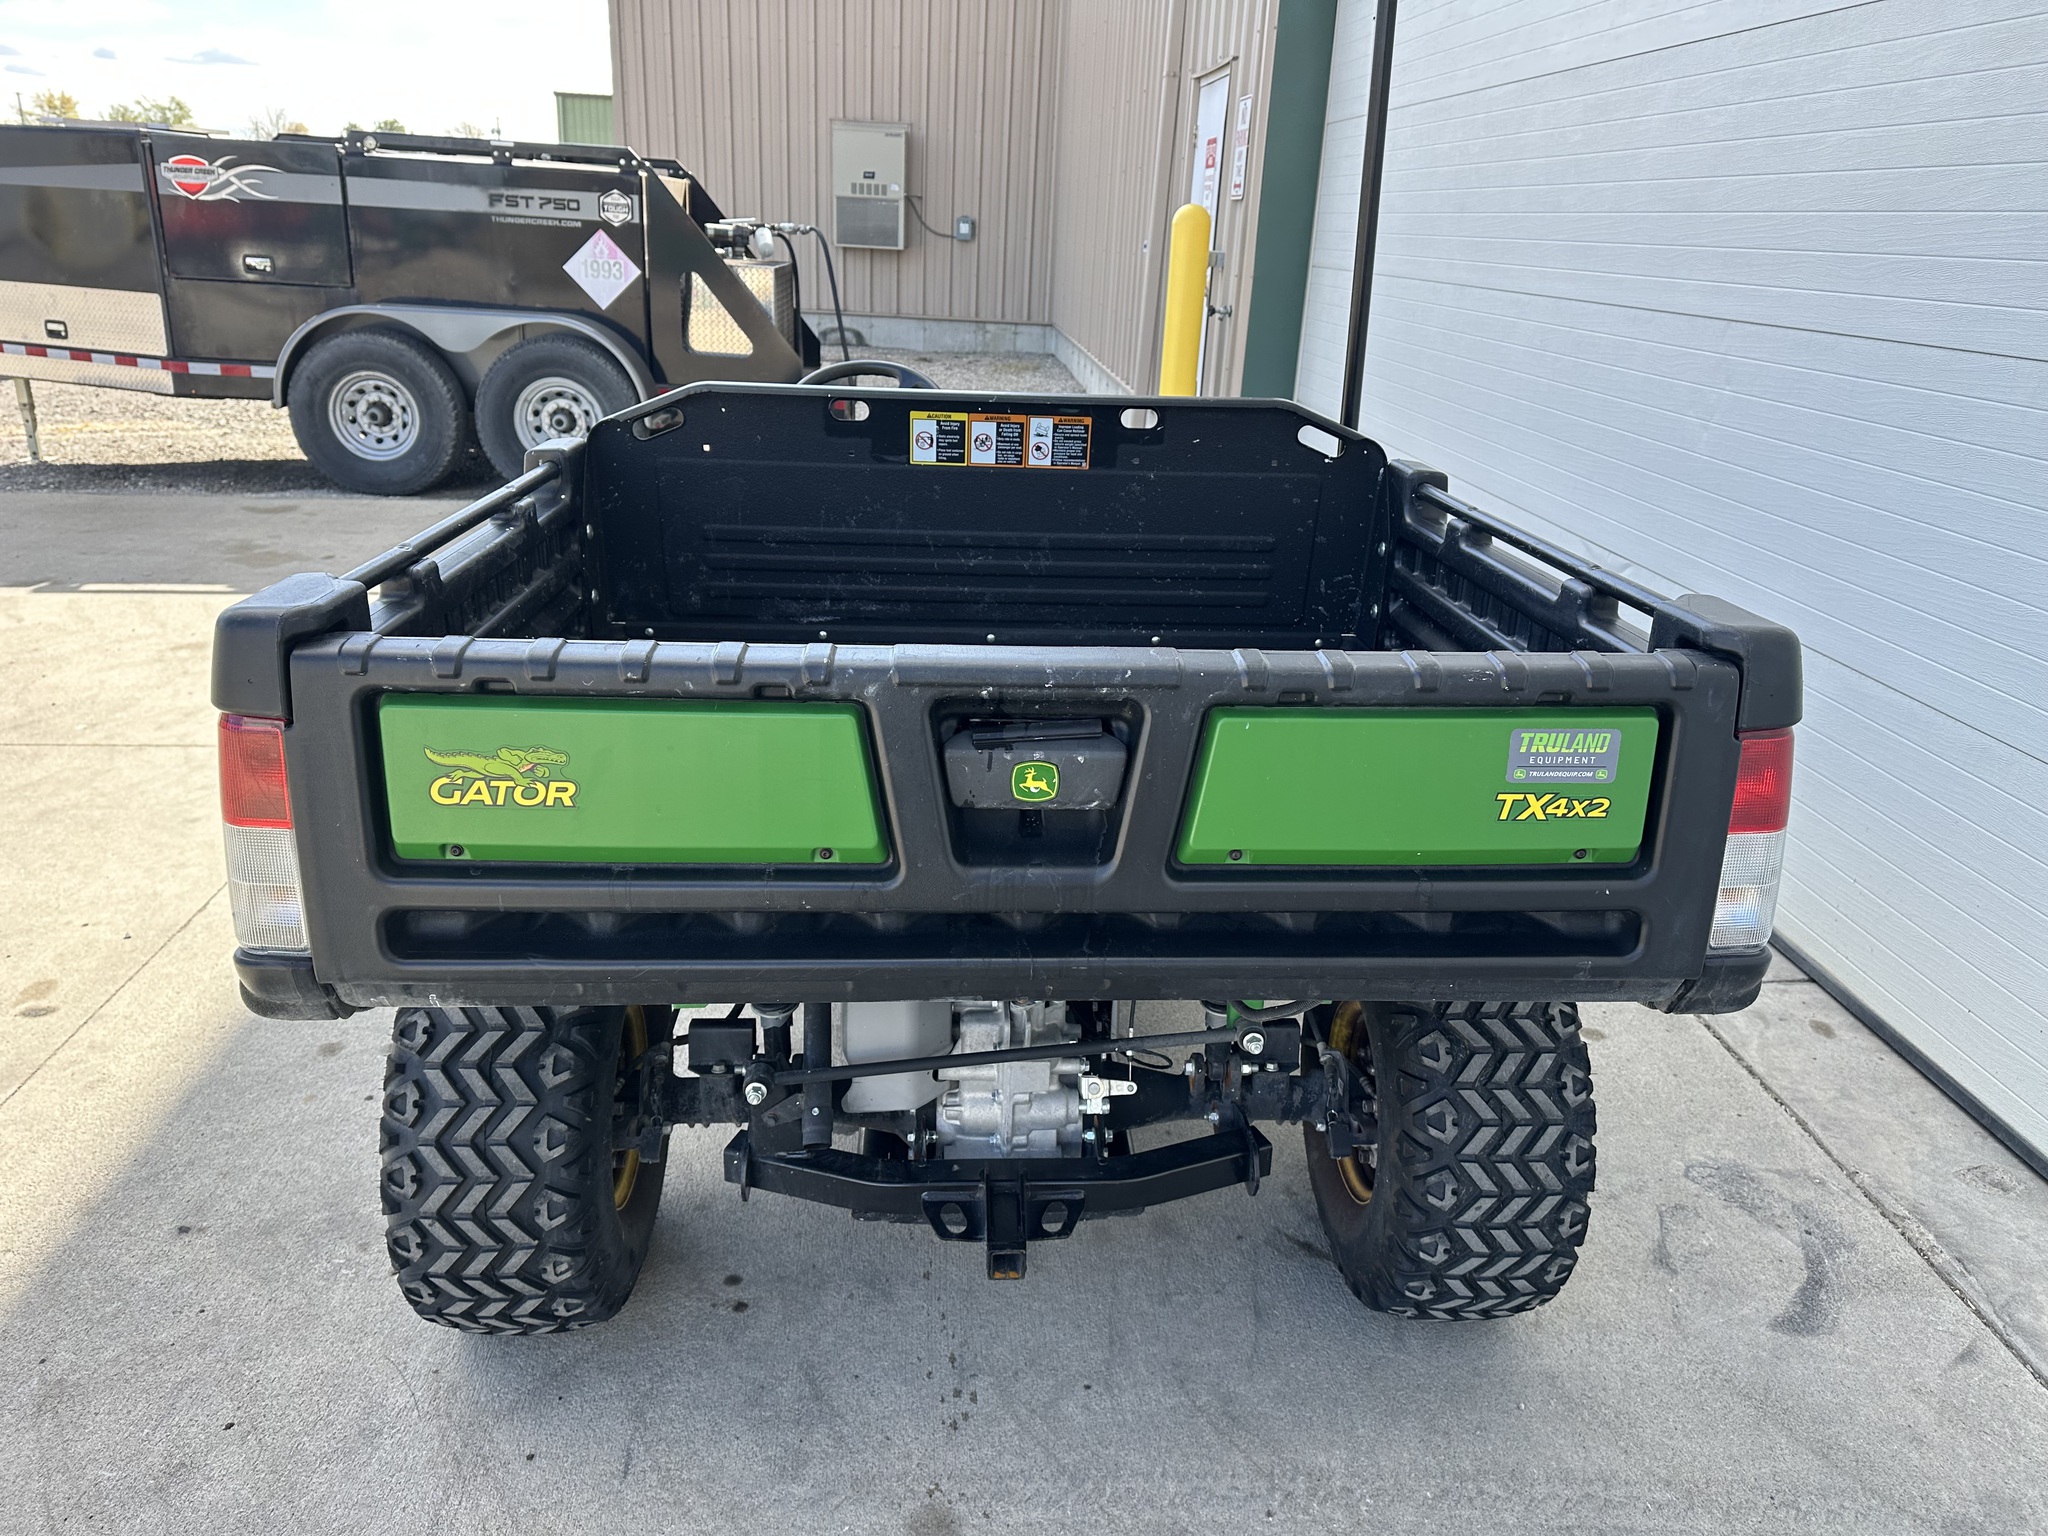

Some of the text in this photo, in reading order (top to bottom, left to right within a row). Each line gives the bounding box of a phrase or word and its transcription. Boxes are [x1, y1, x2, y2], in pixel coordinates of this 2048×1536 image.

[163, 166, 216, 175] THUNDER CREEK
[489, 193, 580, 212] FST 750
[491, 216, 582, 228] THUNDERCREEK.COM
[582, 259, 624, 281] 1993
[1519, 732, 1612, 753] TRULAND
[1529, 756, 1597, 765] EQUIPMENT
[429, 776, 579, 808] GATOR
